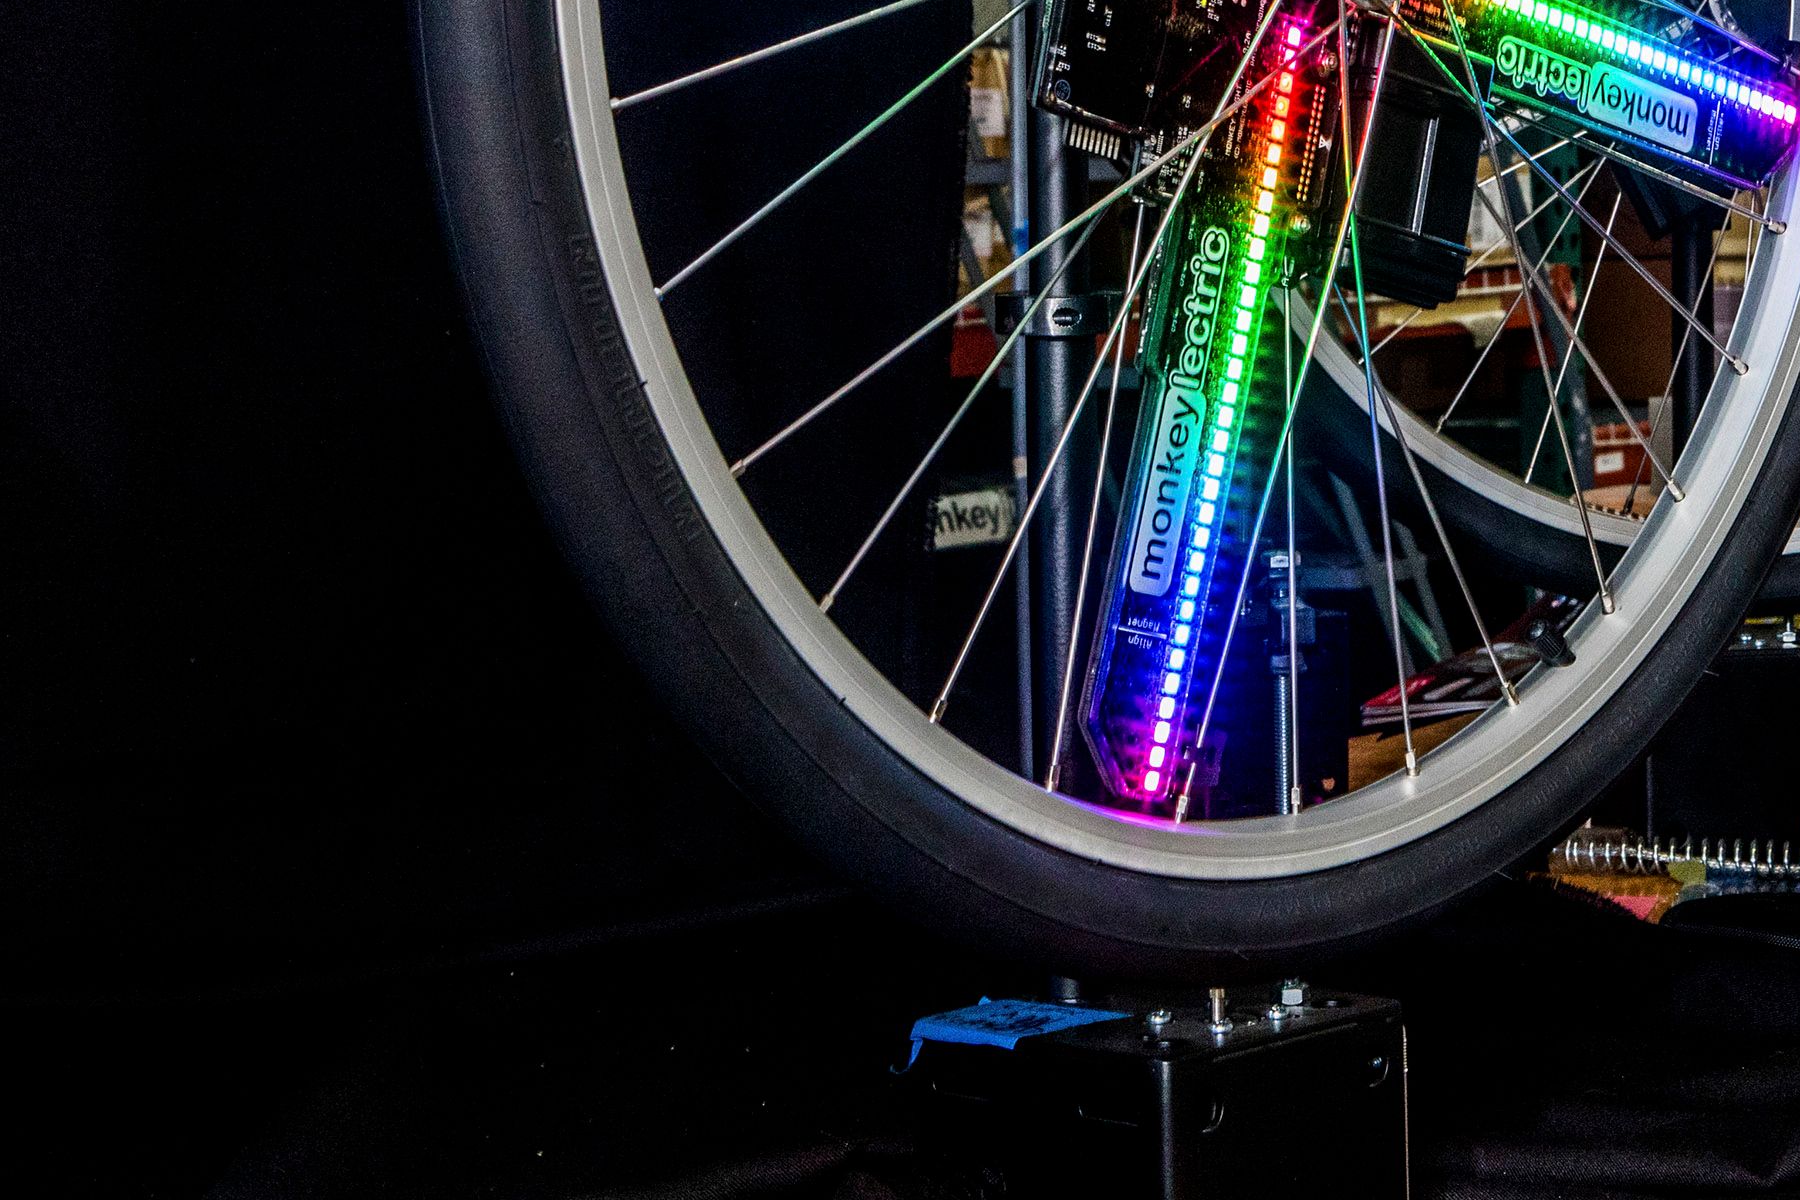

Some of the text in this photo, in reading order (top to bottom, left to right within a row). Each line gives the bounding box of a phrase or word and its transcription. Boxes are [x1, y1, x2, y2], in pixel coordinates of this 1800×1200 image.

[1497, 34, 1691, 139] monkeylectric
[1225, 119, 1237, 157] MONKEY
[1142, 224, 1230, 581] monkeylectric
[1127, 635, 1153, 650] Align
[1128, 617, 1160, 634] Magnet
